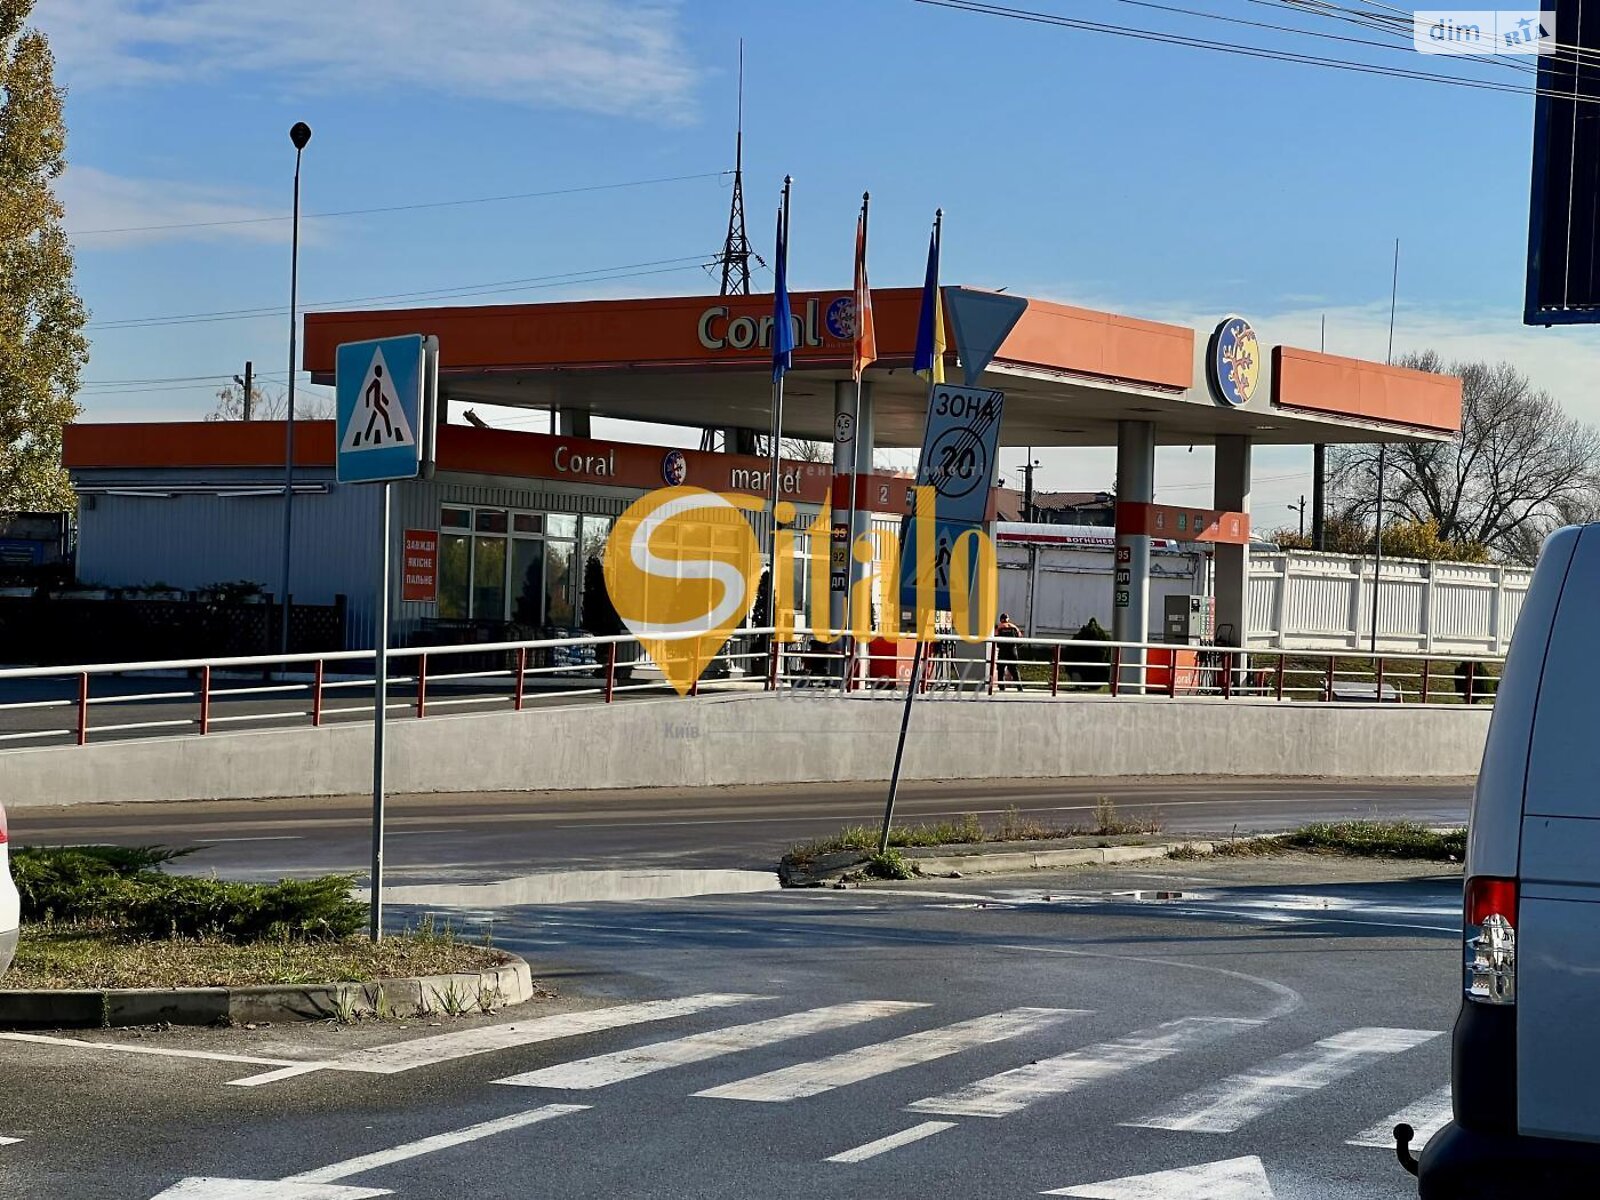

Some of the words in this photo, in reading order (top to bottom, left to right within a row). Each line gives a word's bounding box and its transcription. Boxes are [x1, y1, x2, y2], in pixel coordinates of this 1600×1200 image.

[936, 392, 996, 421] ЗОНА
[554, 446, 616, 477] Coral
[939, 444, 976, 480] 20
[880, 487, 888, 503] 2
[1117, 550, 1129, 560] 95
[406, 574, 433, 585] ПАЛЬНЕ
